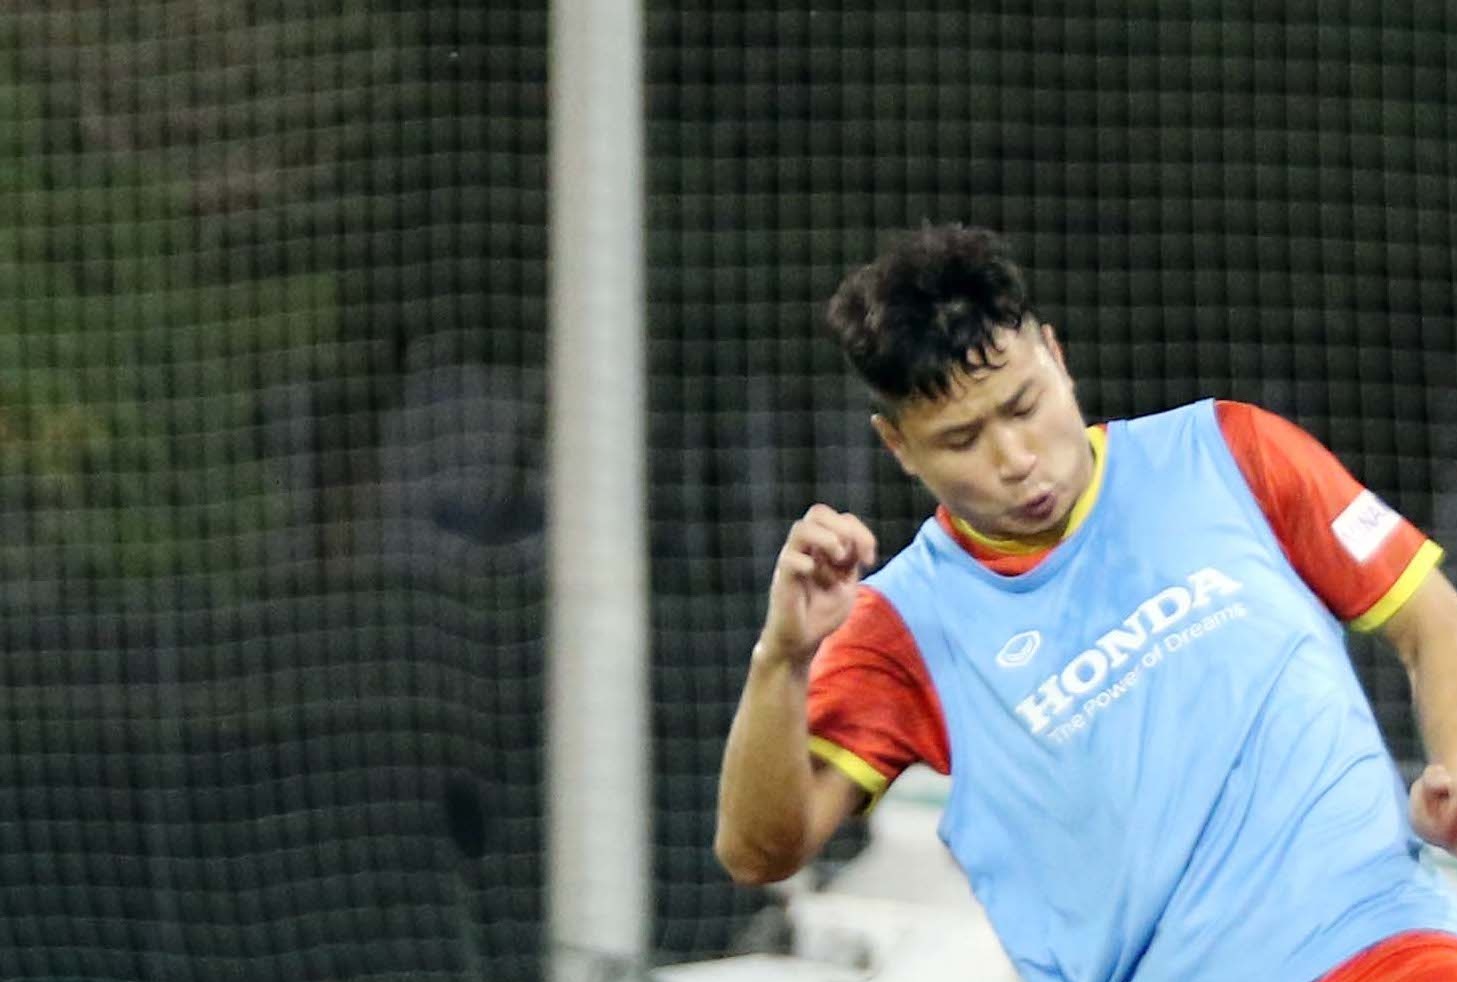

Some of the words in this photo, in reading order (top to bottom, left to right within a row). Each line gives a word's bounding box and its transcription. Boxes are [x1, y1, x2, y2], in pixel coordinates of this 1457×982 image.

[1015, 567, 1243, 733] HONDA
[1047, 714, 1085, 743] The
[1083, 663, 1142, 717] Power
[1142, 643, 1163, 668] of
[1163, 602, 1248, 652] Dreams
